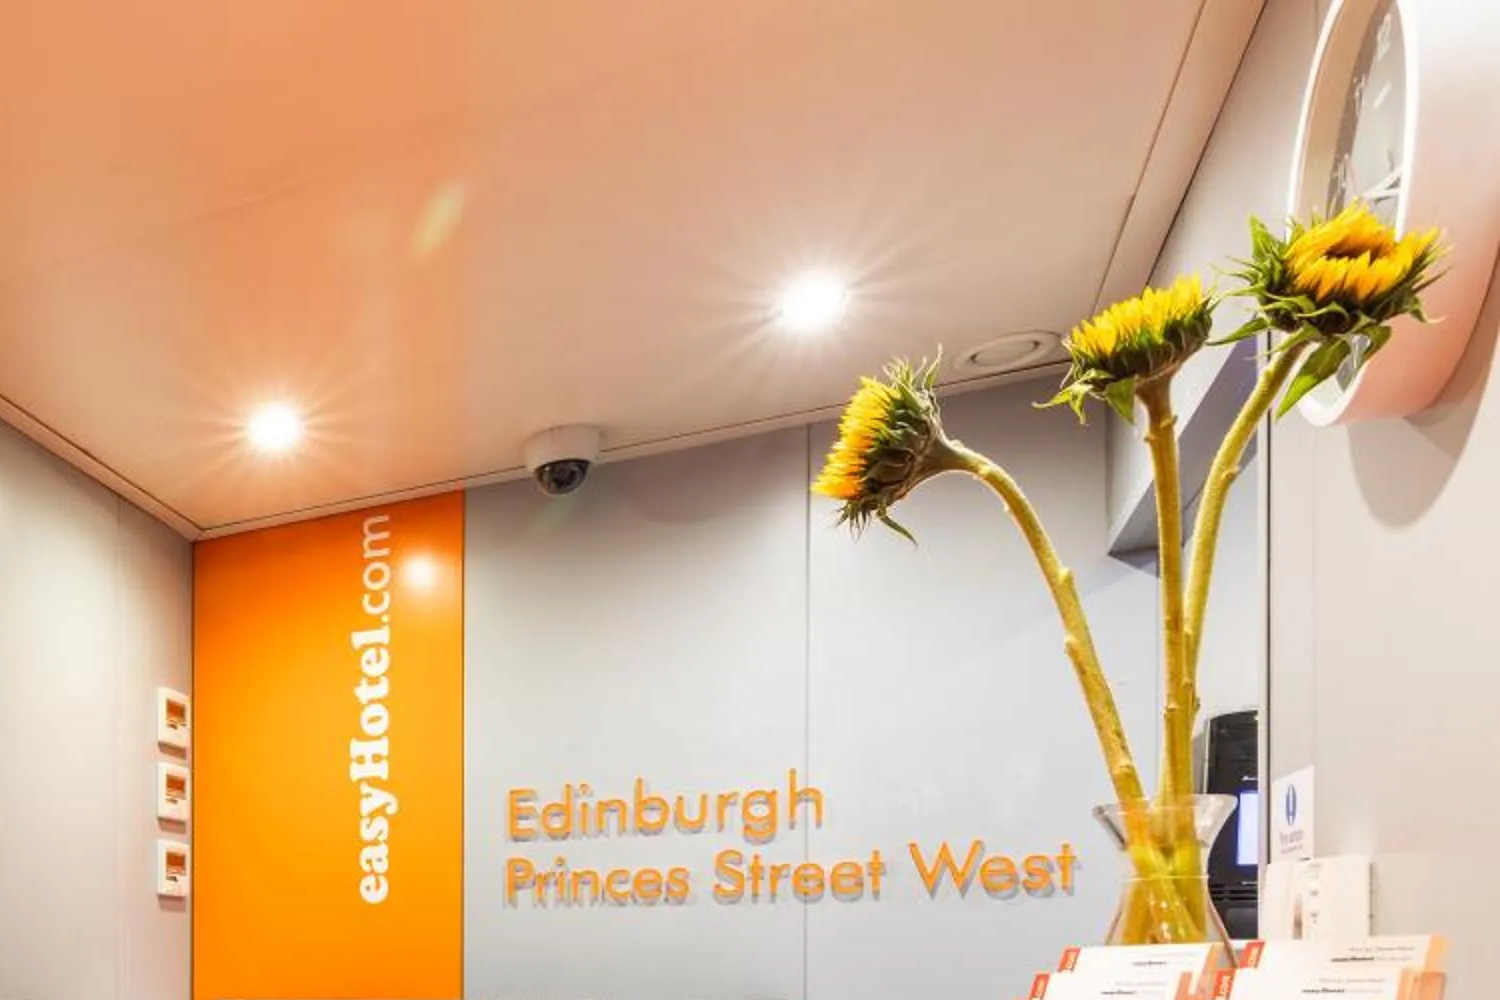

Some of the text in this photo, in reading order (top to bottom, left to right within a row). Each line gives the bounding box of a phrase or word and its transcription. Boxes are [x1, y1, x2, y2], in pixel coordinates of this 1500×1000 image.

[349, 513, 398, 904] easyHotel.com
[505, 767, 826, 842] Edinburgh
[503, 838, 1078, 906] Princes Street West
